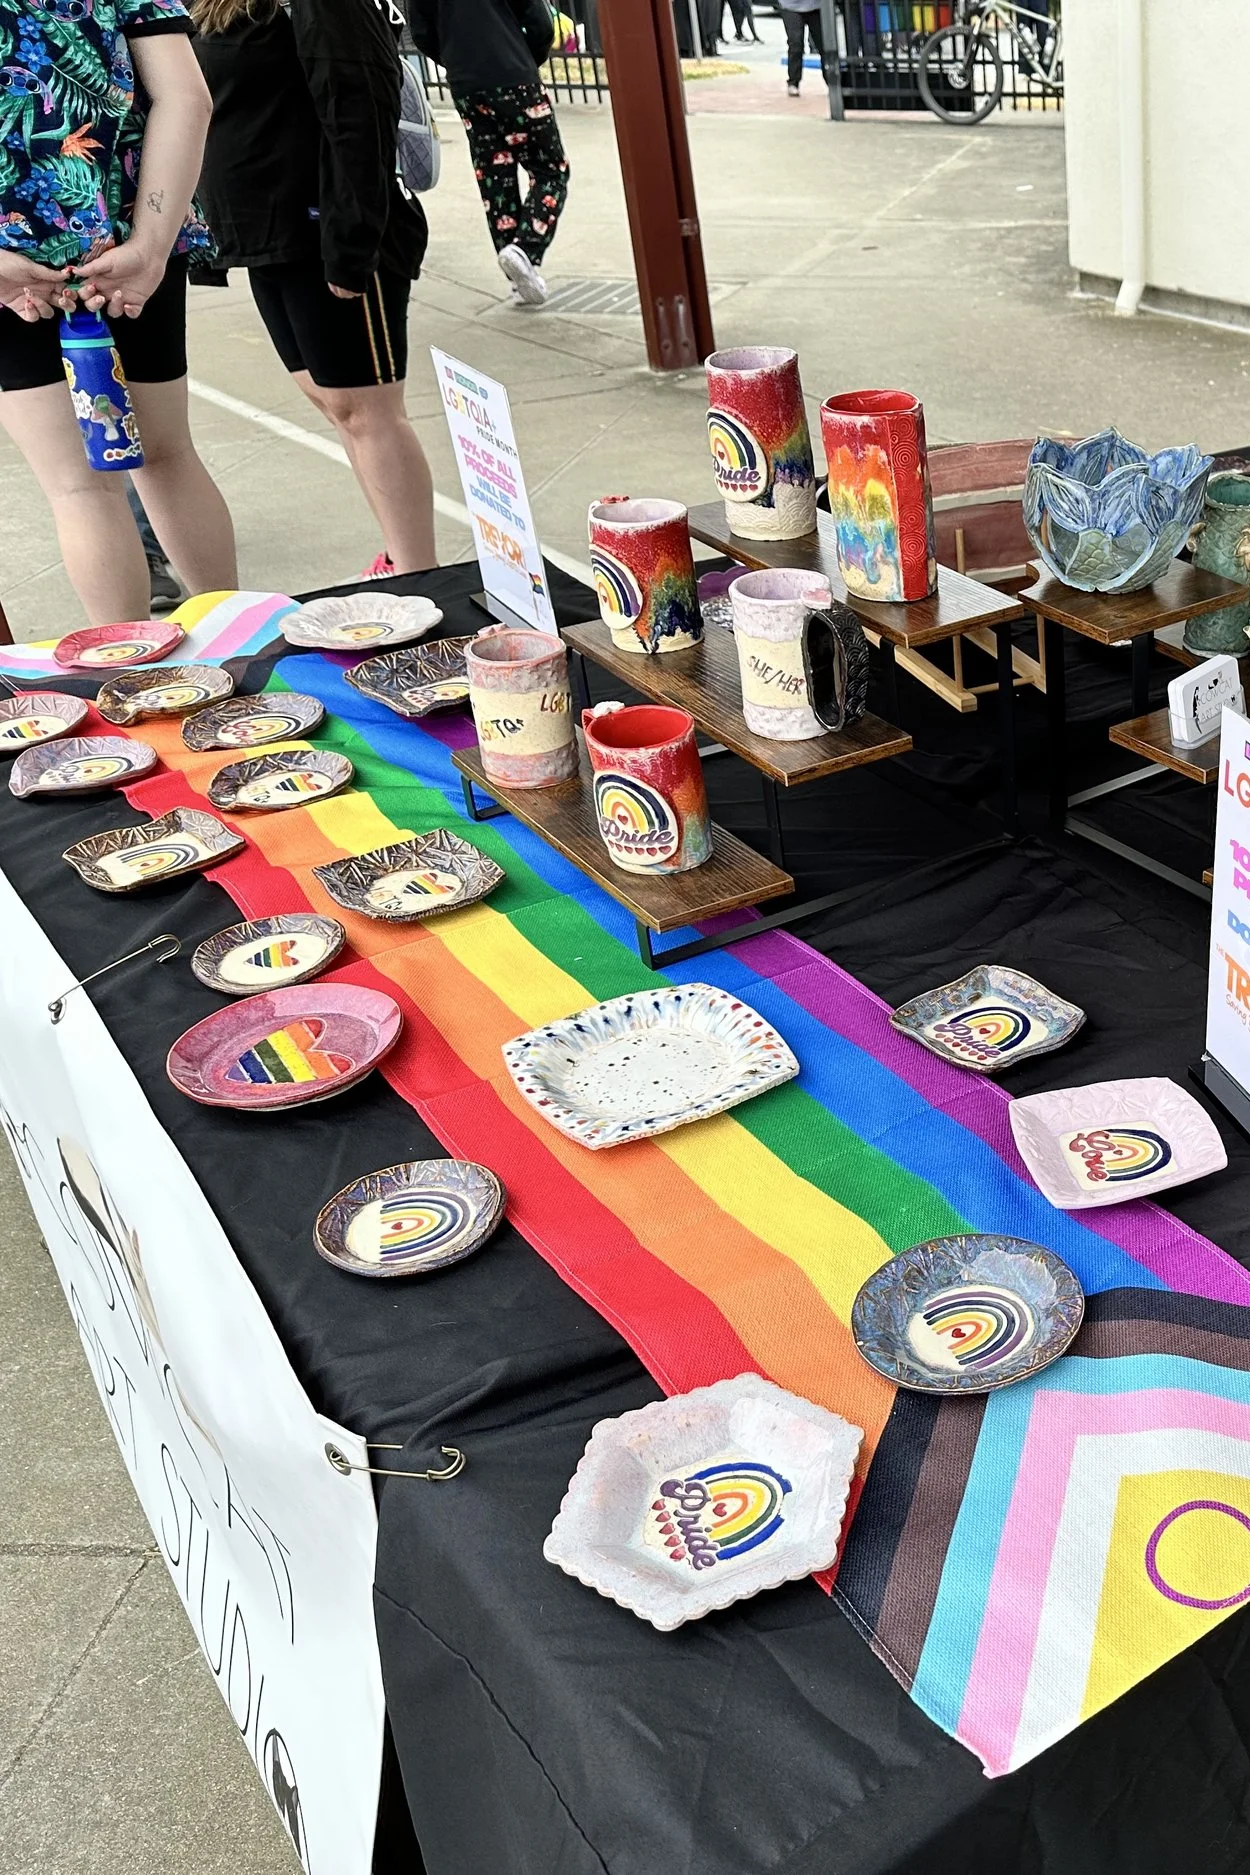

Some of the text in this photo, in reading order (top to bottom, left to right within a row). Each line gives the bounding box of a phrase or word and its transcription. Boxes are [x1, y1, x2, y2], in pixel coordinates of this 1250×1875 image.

[481, 449, 495, 467] OF
[496, 459, 517, 483] ALL
[495, 438, 518, 459] MONTH
[464, 453, 518, 499] PROCEEDS
[477, 475, 498, 499] WILL
[712, 455, 761, 483] Pride
[469, 484, 526, 531] DONATED TO
[747, 655, 802, 695] SHE/HER
[600, 816, 675, 846] Pride
[1225, 993, 1247, 1026] Saving
[933, 1022, 1001, 1058] Pride
[1069, 1131, 1116, 1181] Love
[660, 1479, 719, 1571] Pride
[160, 1442, 313, 1875] STUDIO
